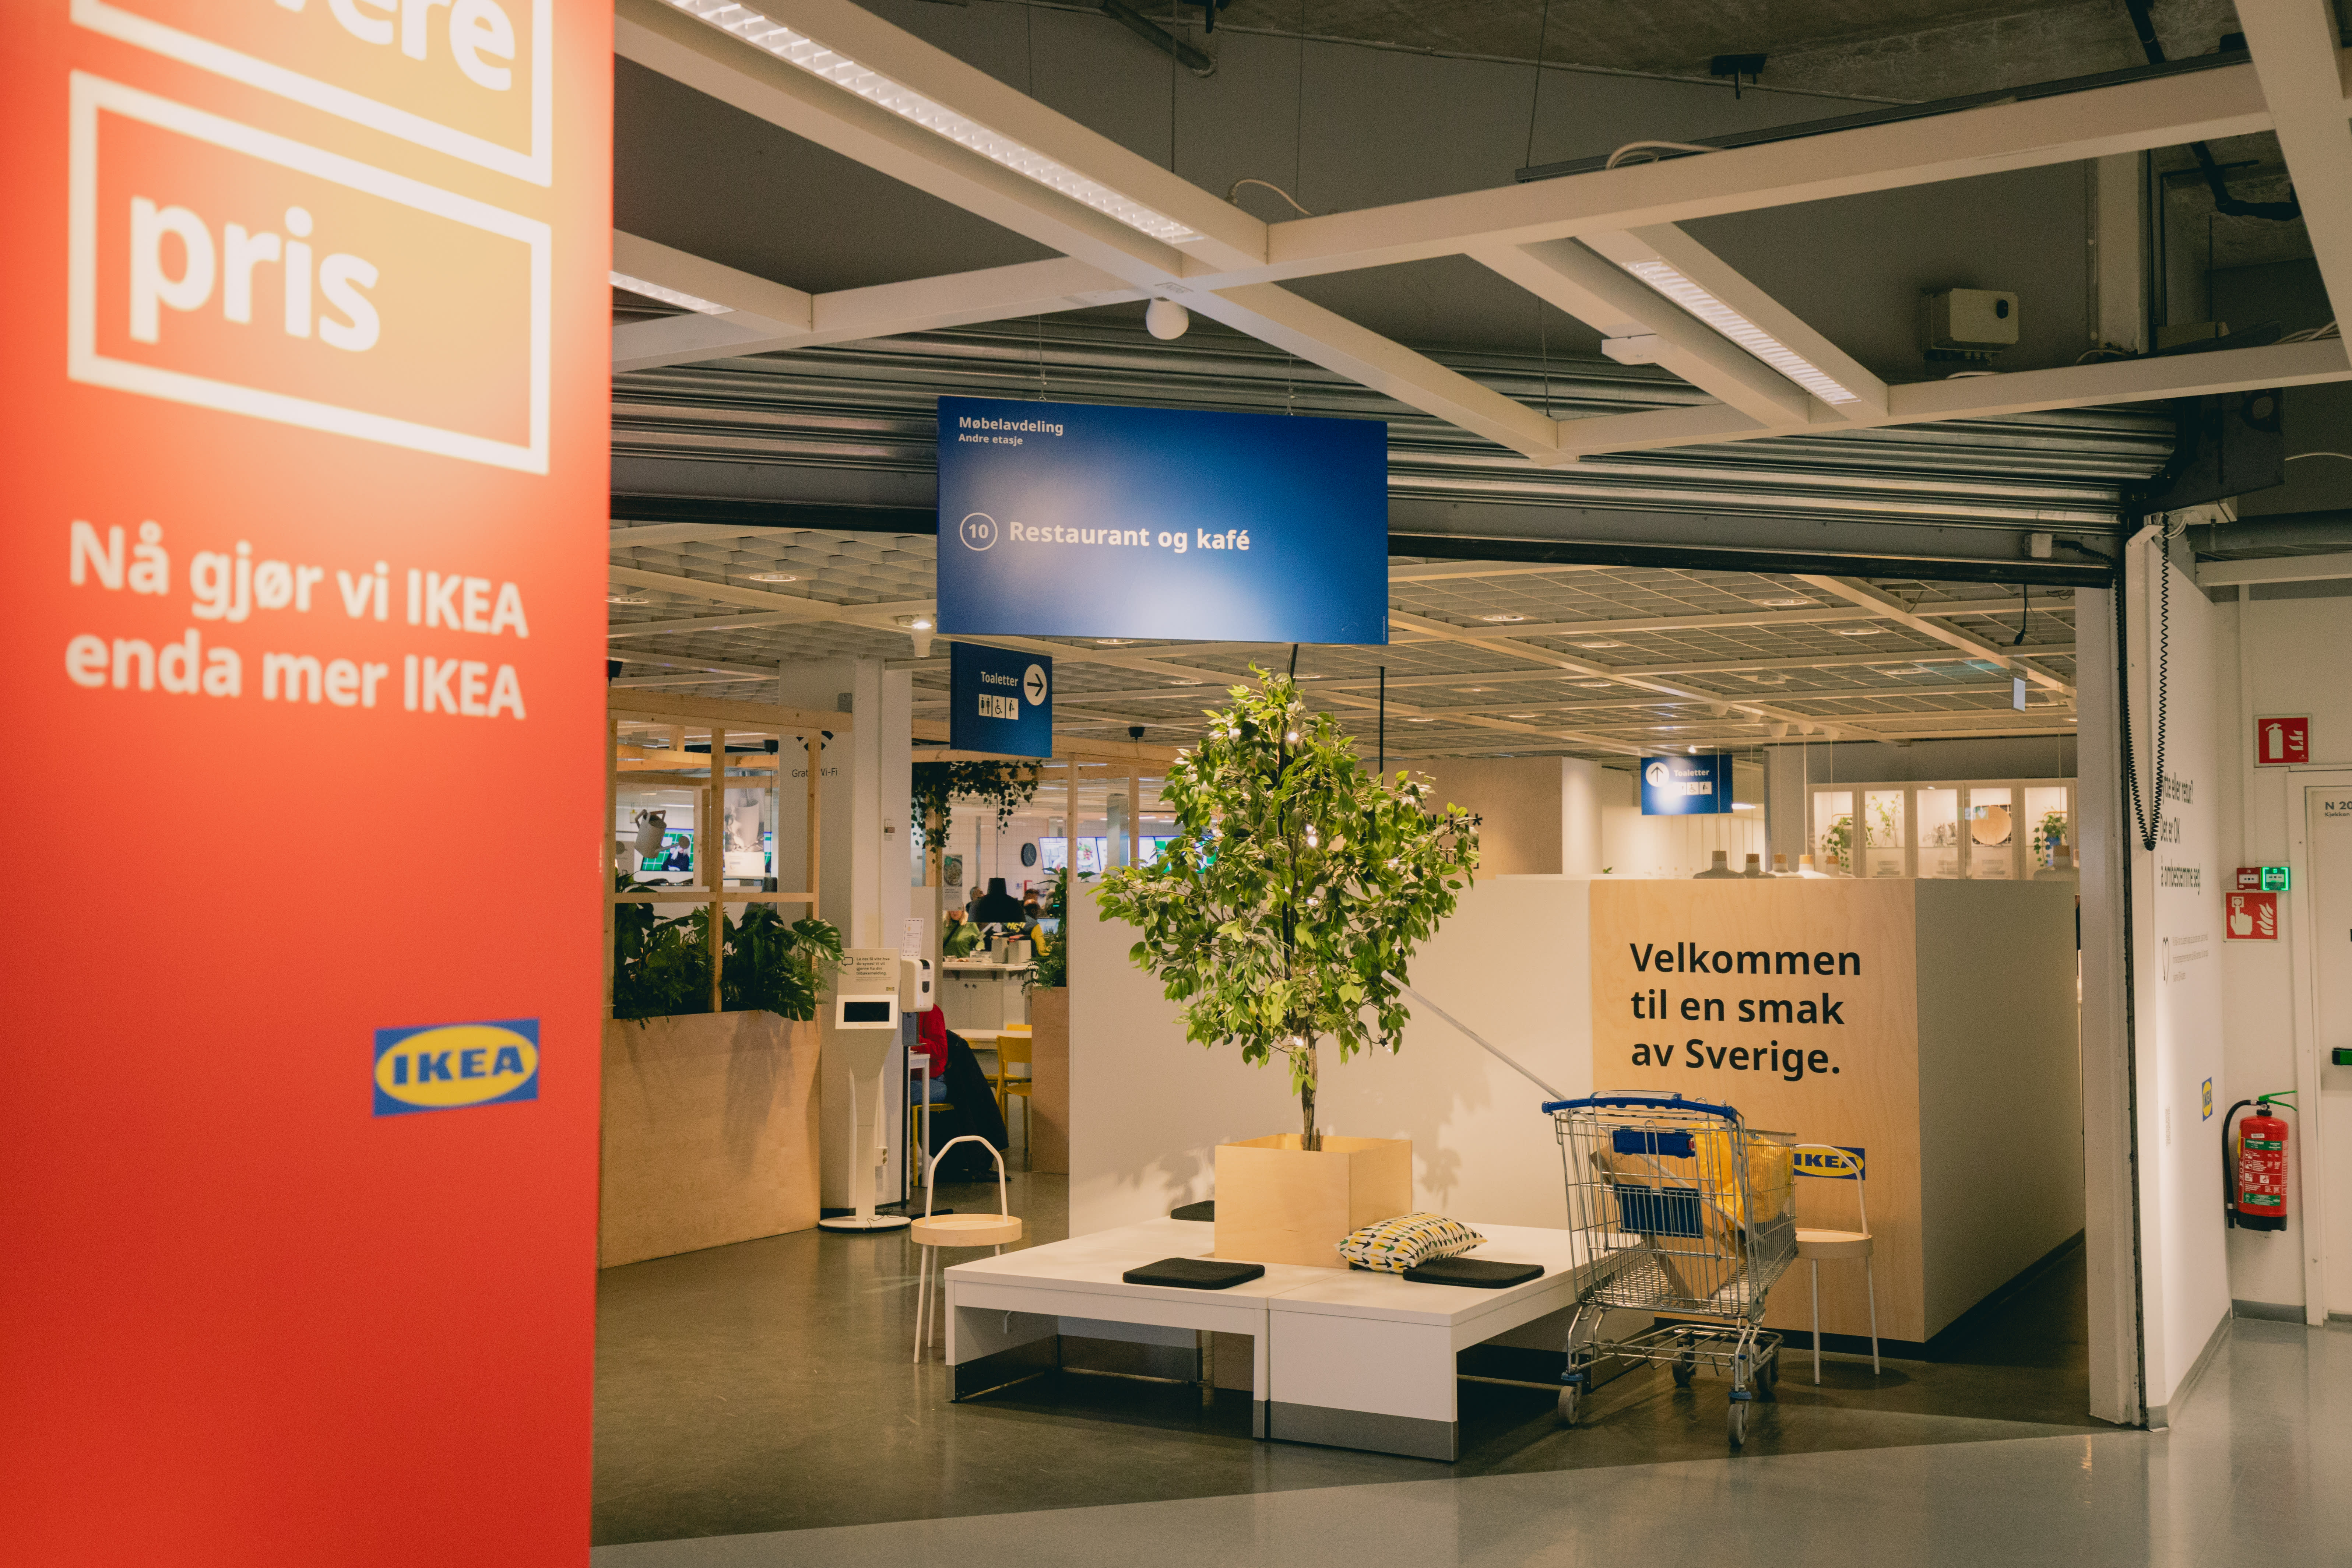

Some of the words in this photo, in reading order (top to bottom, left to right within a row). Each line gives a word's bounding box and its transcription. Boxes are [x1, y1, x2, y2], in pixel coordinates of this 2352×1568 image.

[130, 195, 380, 352] pris
[959, 434, 989, 443] Andre
[992, 436, 1023, 446] etasje
[960, 417, 1063, 436] Møbelavdeling
[968, 524, 988, 539] 10
[1010, 521, 1150, 546] Restaurant
[1158, 531, 1188, 553] og
[1197, 528, 1250, 551] kafé
[70, 520, 170, 595] Nå
[189, 540, 324, 623] gjør
[336, 561, 389, 621] vi
[407, 569, 530, 638] IKEA
[65, 628, 242, 698] enda
[262, 652, 389, 709] mer
[404, 654, 526, 720] IKEA
[981, 671, 1019, 687] Toaletter
[2172, 772, 2181, 802] eller
[2325, 802, 2334, 810] N
[2169, 822, 2173, 843] er
[2174, 817, 2180, 844] OK
[1629, 942, 1860, 975] Velkommen
[1631, 989, 1667, 1019] til
[1680, 998, 1725, 1021] en
[1738, 992, 1845, 1024] smak
[394, 1045, 525, 1086] IKEA
[1631, 1043, 1674, 1067] av
[1686, 1038, 1840, 1082] Sverige.
